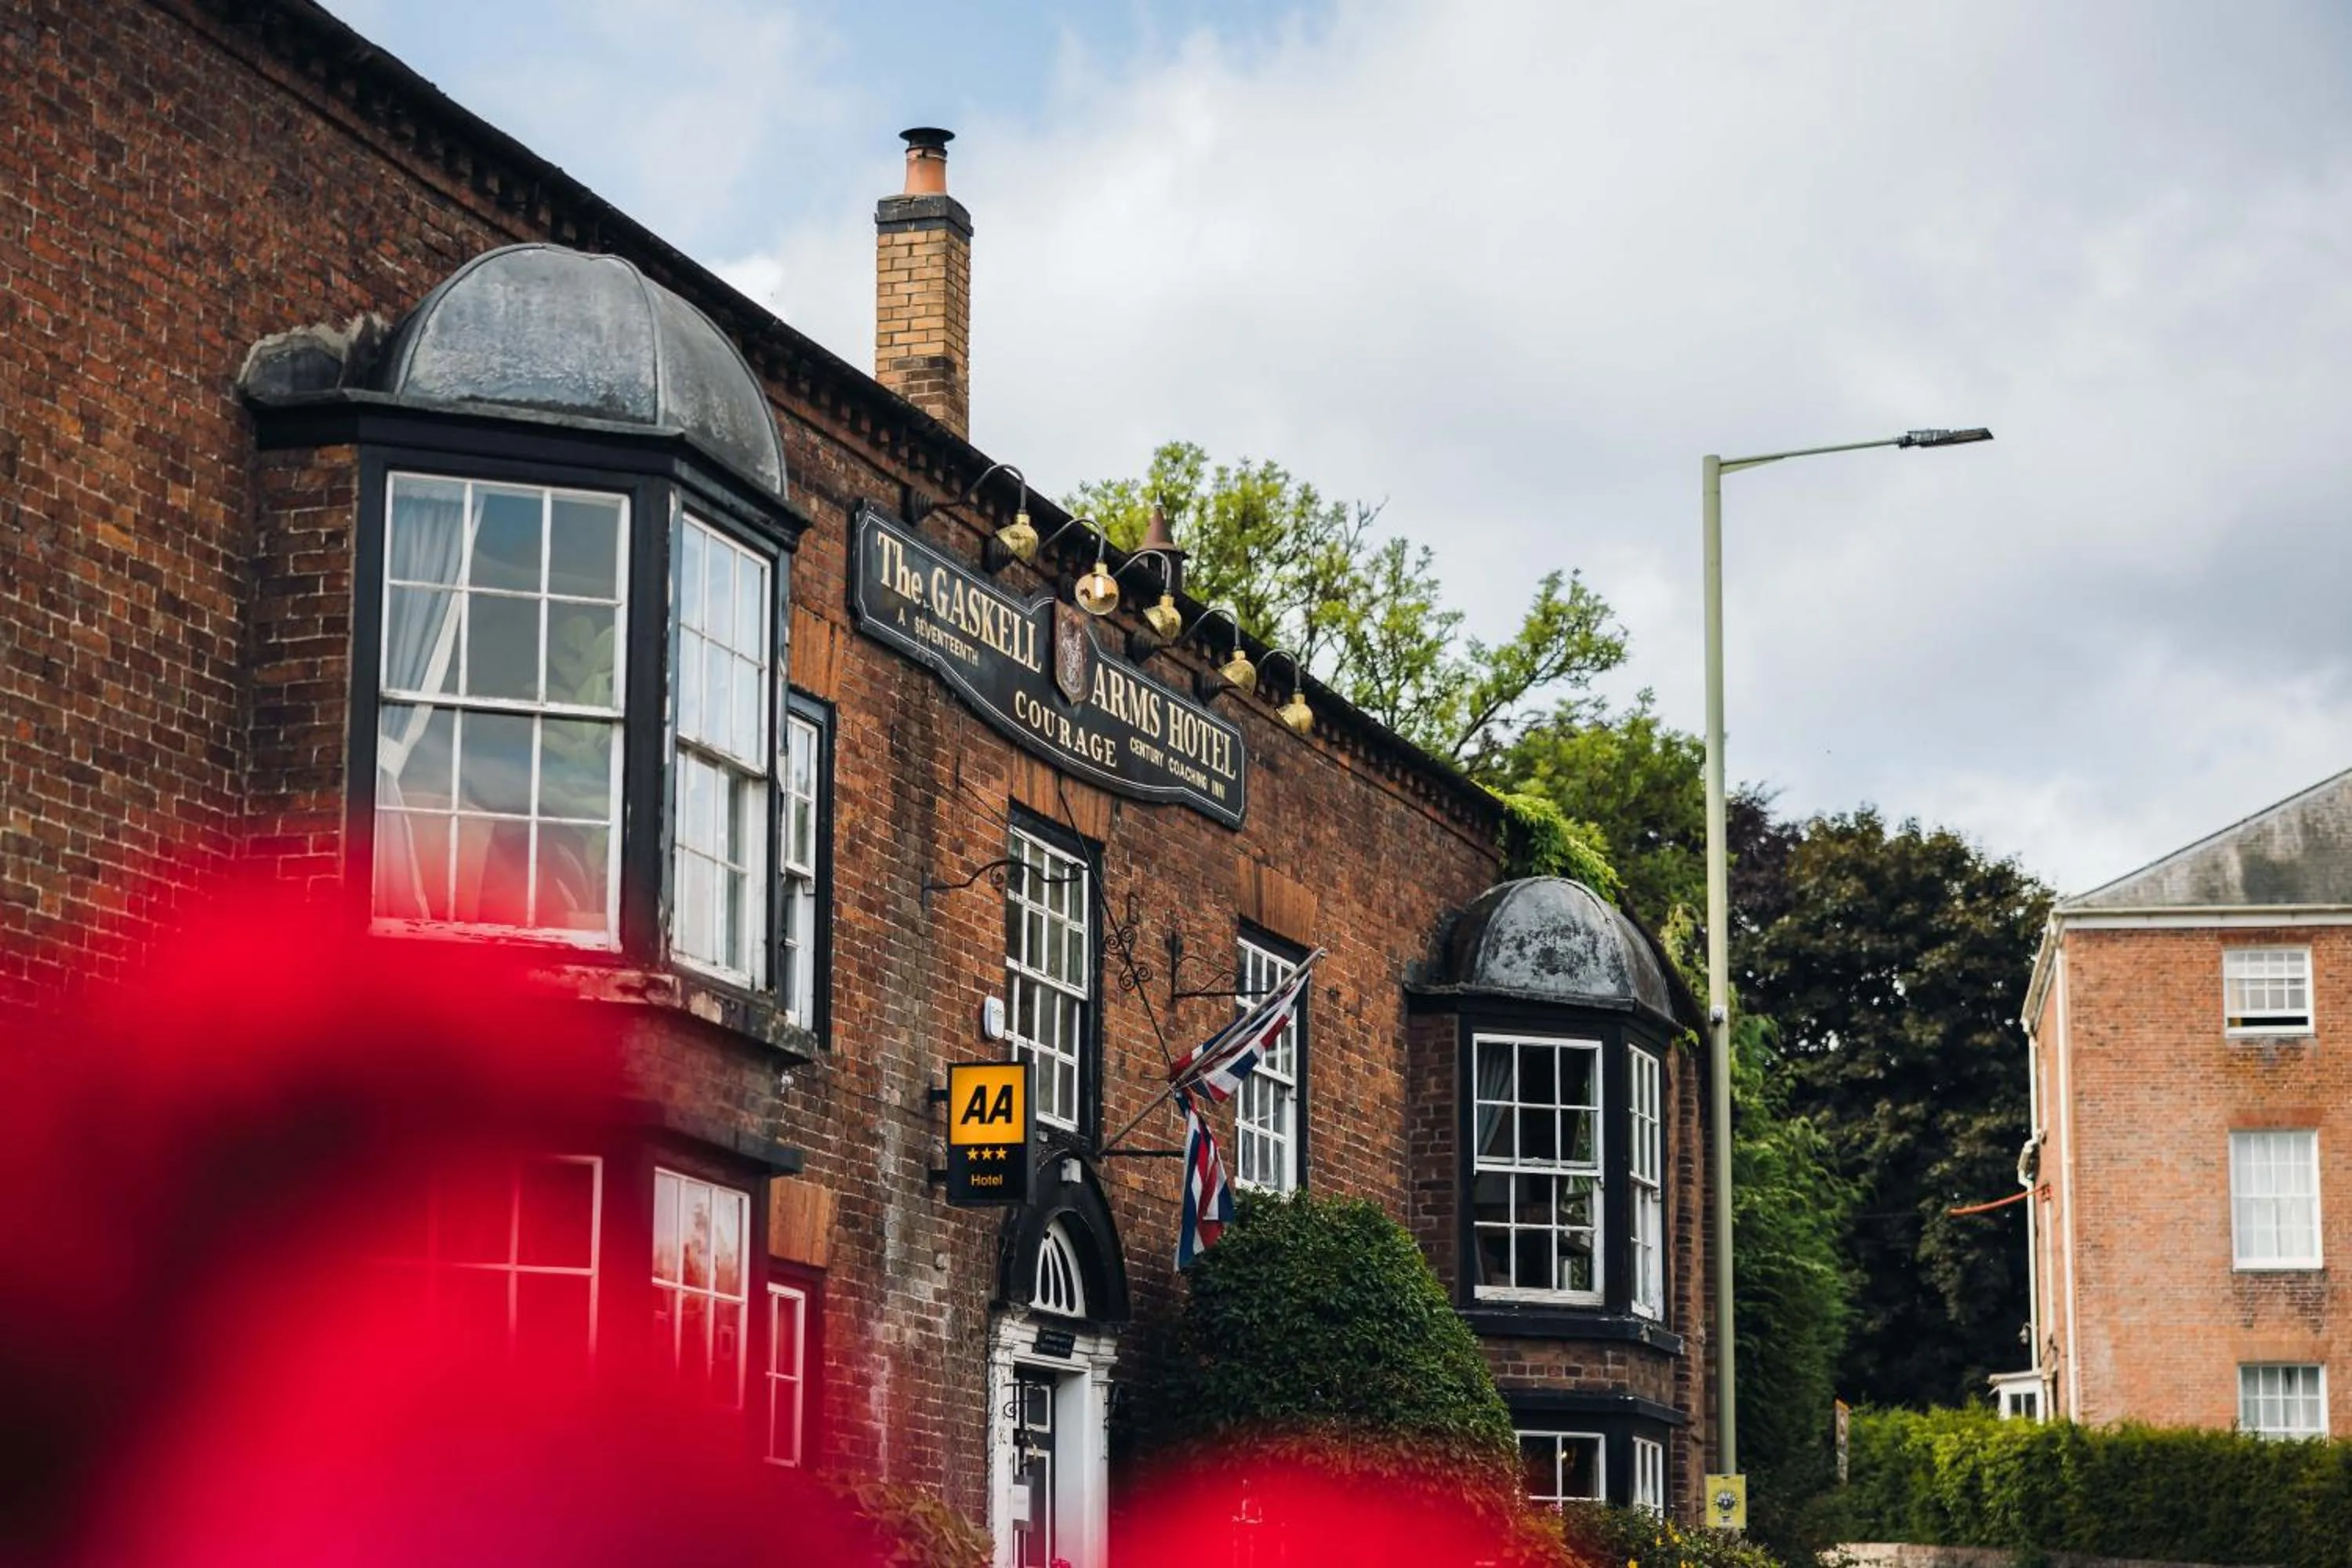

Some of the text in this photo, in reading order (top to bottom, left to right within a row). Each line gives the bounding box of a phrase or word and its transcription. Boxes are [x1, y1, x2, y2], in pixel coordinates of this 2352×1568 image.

[877, 531, 1236, 781] The GASKELL ARMS HOTEL
[897, 607, 979, 666] A SEVENTEENTH
[1014, 690, 1117, 768] COURAGE
[1130, 736, 1225, 800] CENTURY COACHING INN
[960, 1084, 1014, 1125] AA
[971, 1174, 1003, 1186] Hotel
